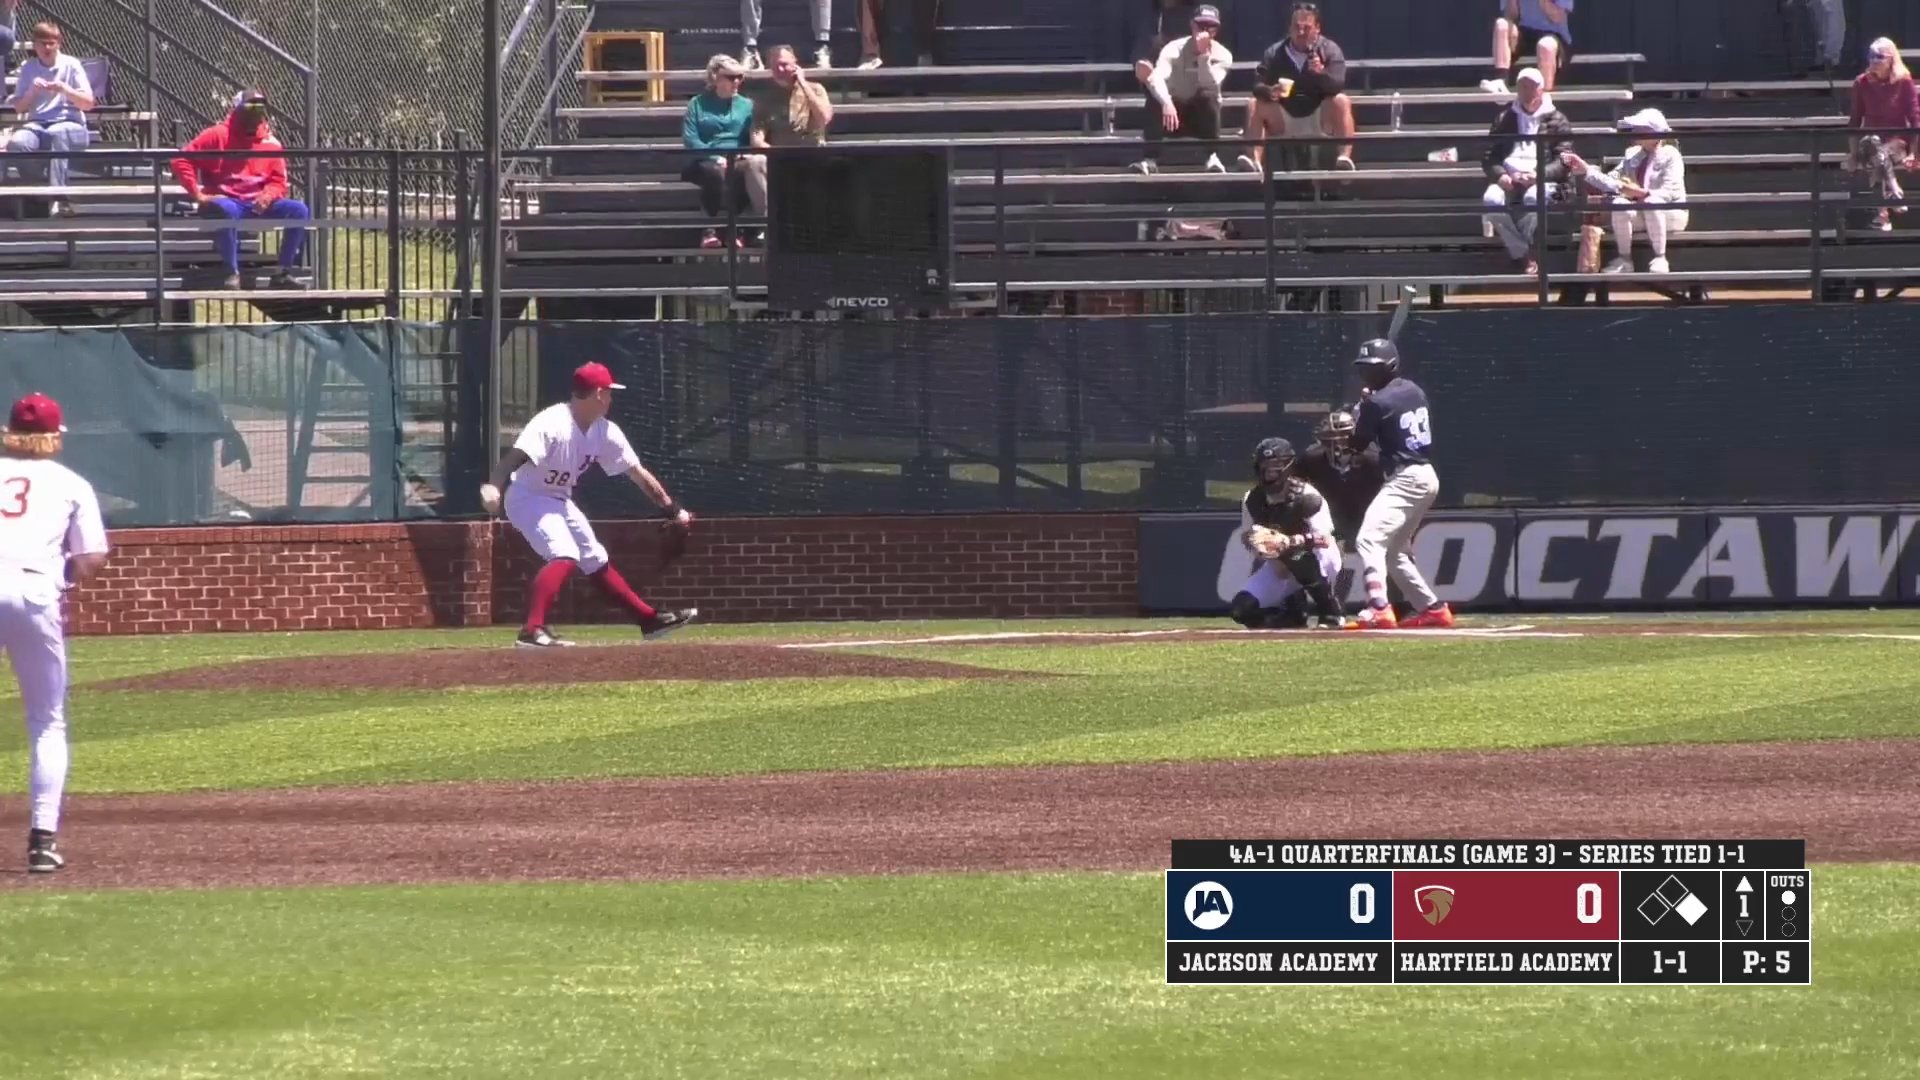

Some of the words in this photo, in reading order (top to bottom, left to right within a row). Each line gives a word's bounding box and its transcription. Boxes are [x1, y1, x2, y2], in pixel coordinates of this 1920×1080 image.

[836, 297, 889, 307] NEVCO
[544, 469, 571, 487] 38
[1217, 513, 1920, 605] OCTAW
